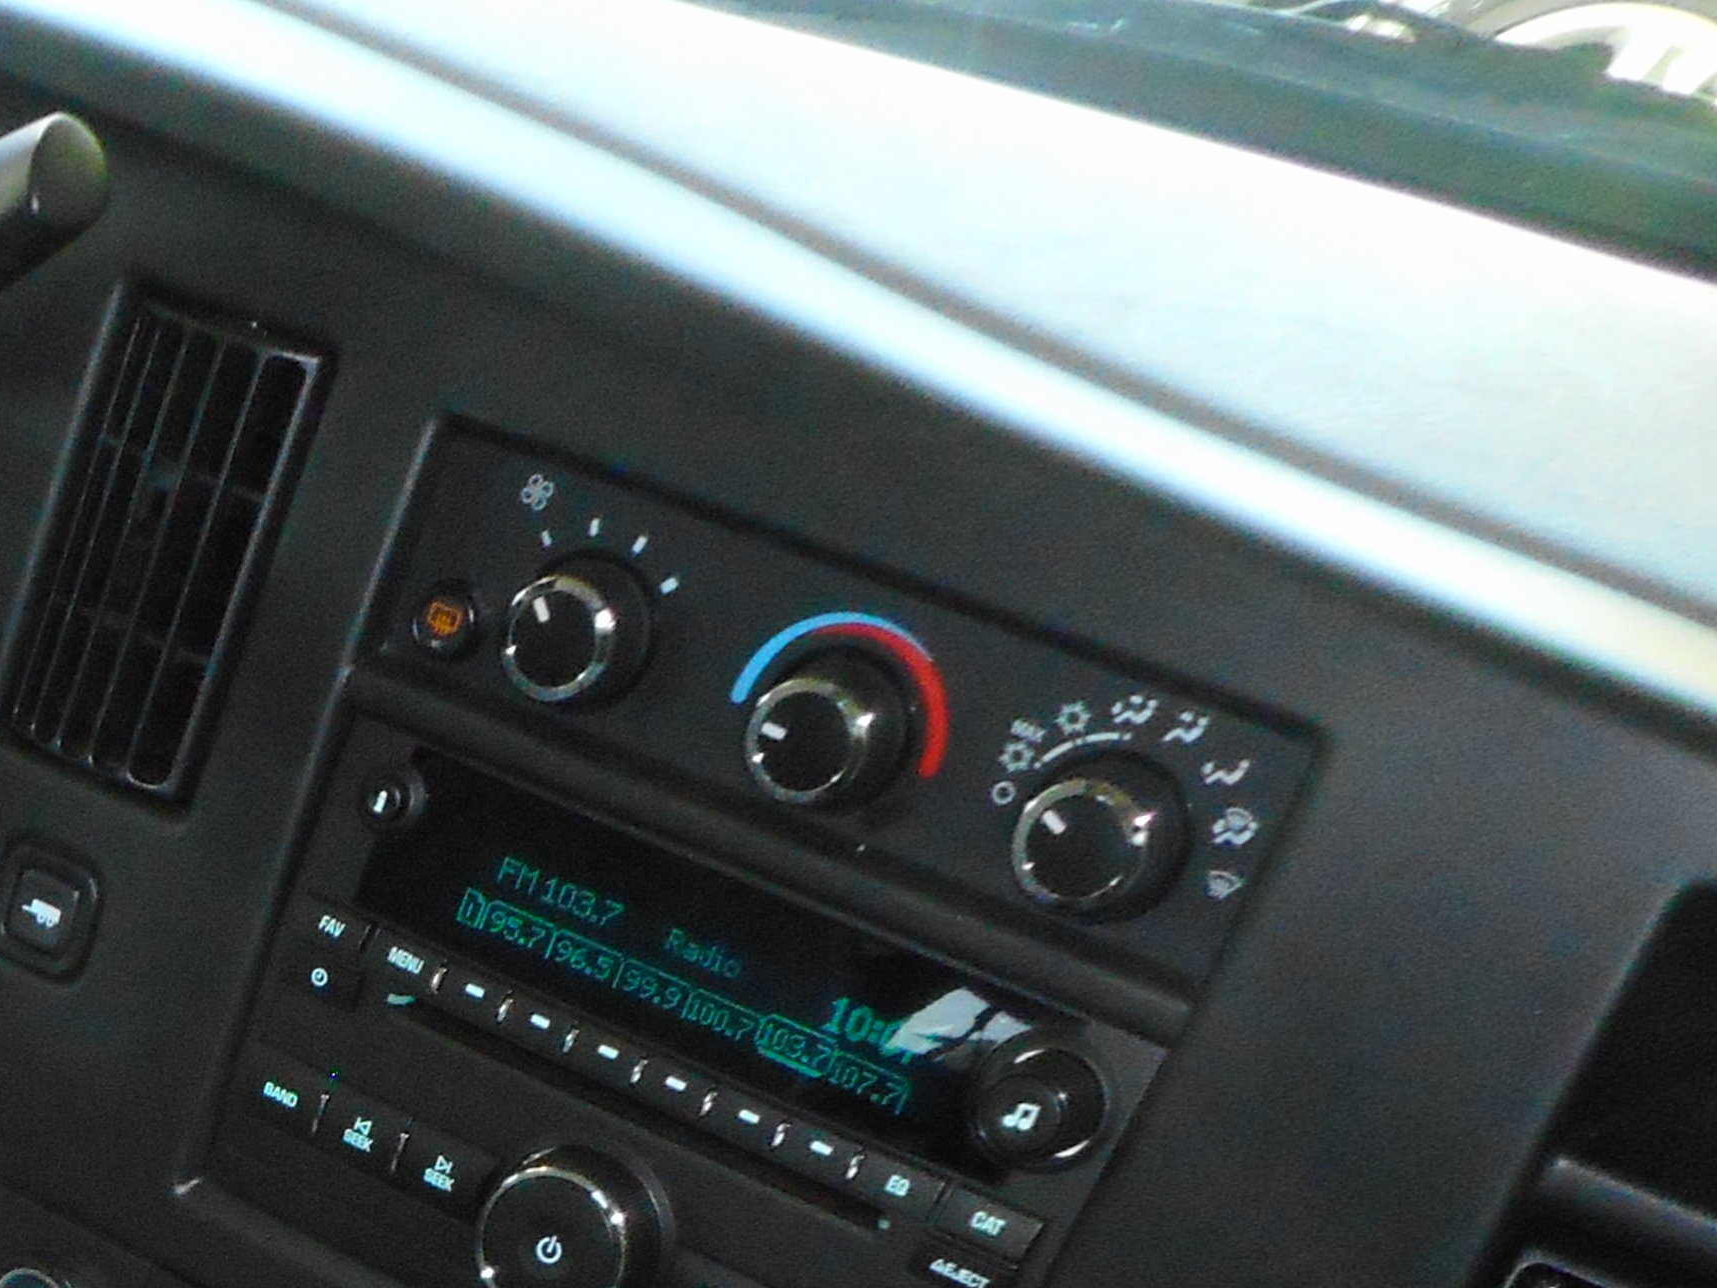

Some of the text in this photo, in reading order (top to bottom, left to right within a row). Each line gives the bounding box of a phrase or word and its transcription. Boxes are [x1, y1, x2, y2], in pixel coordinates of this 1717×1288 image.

[318, 914, 346, 938] FAV
[386, 946, 425, 975] MENU
[665, 927, 743, 979] Radio
[488, 910, 546, 949] 95.7
[556, 938, 615, 983] 96.5
[685, 1002, 755, 1042] 100.7
[262, 1080, 299, 1109] BAND
[342, 1127, 374, 1153] SEEK
[422, 1167, 455, 1192] SEEK
[884, 1174, 911, 1198] EQ
[969, 1210, 1007, 1237] CAT
